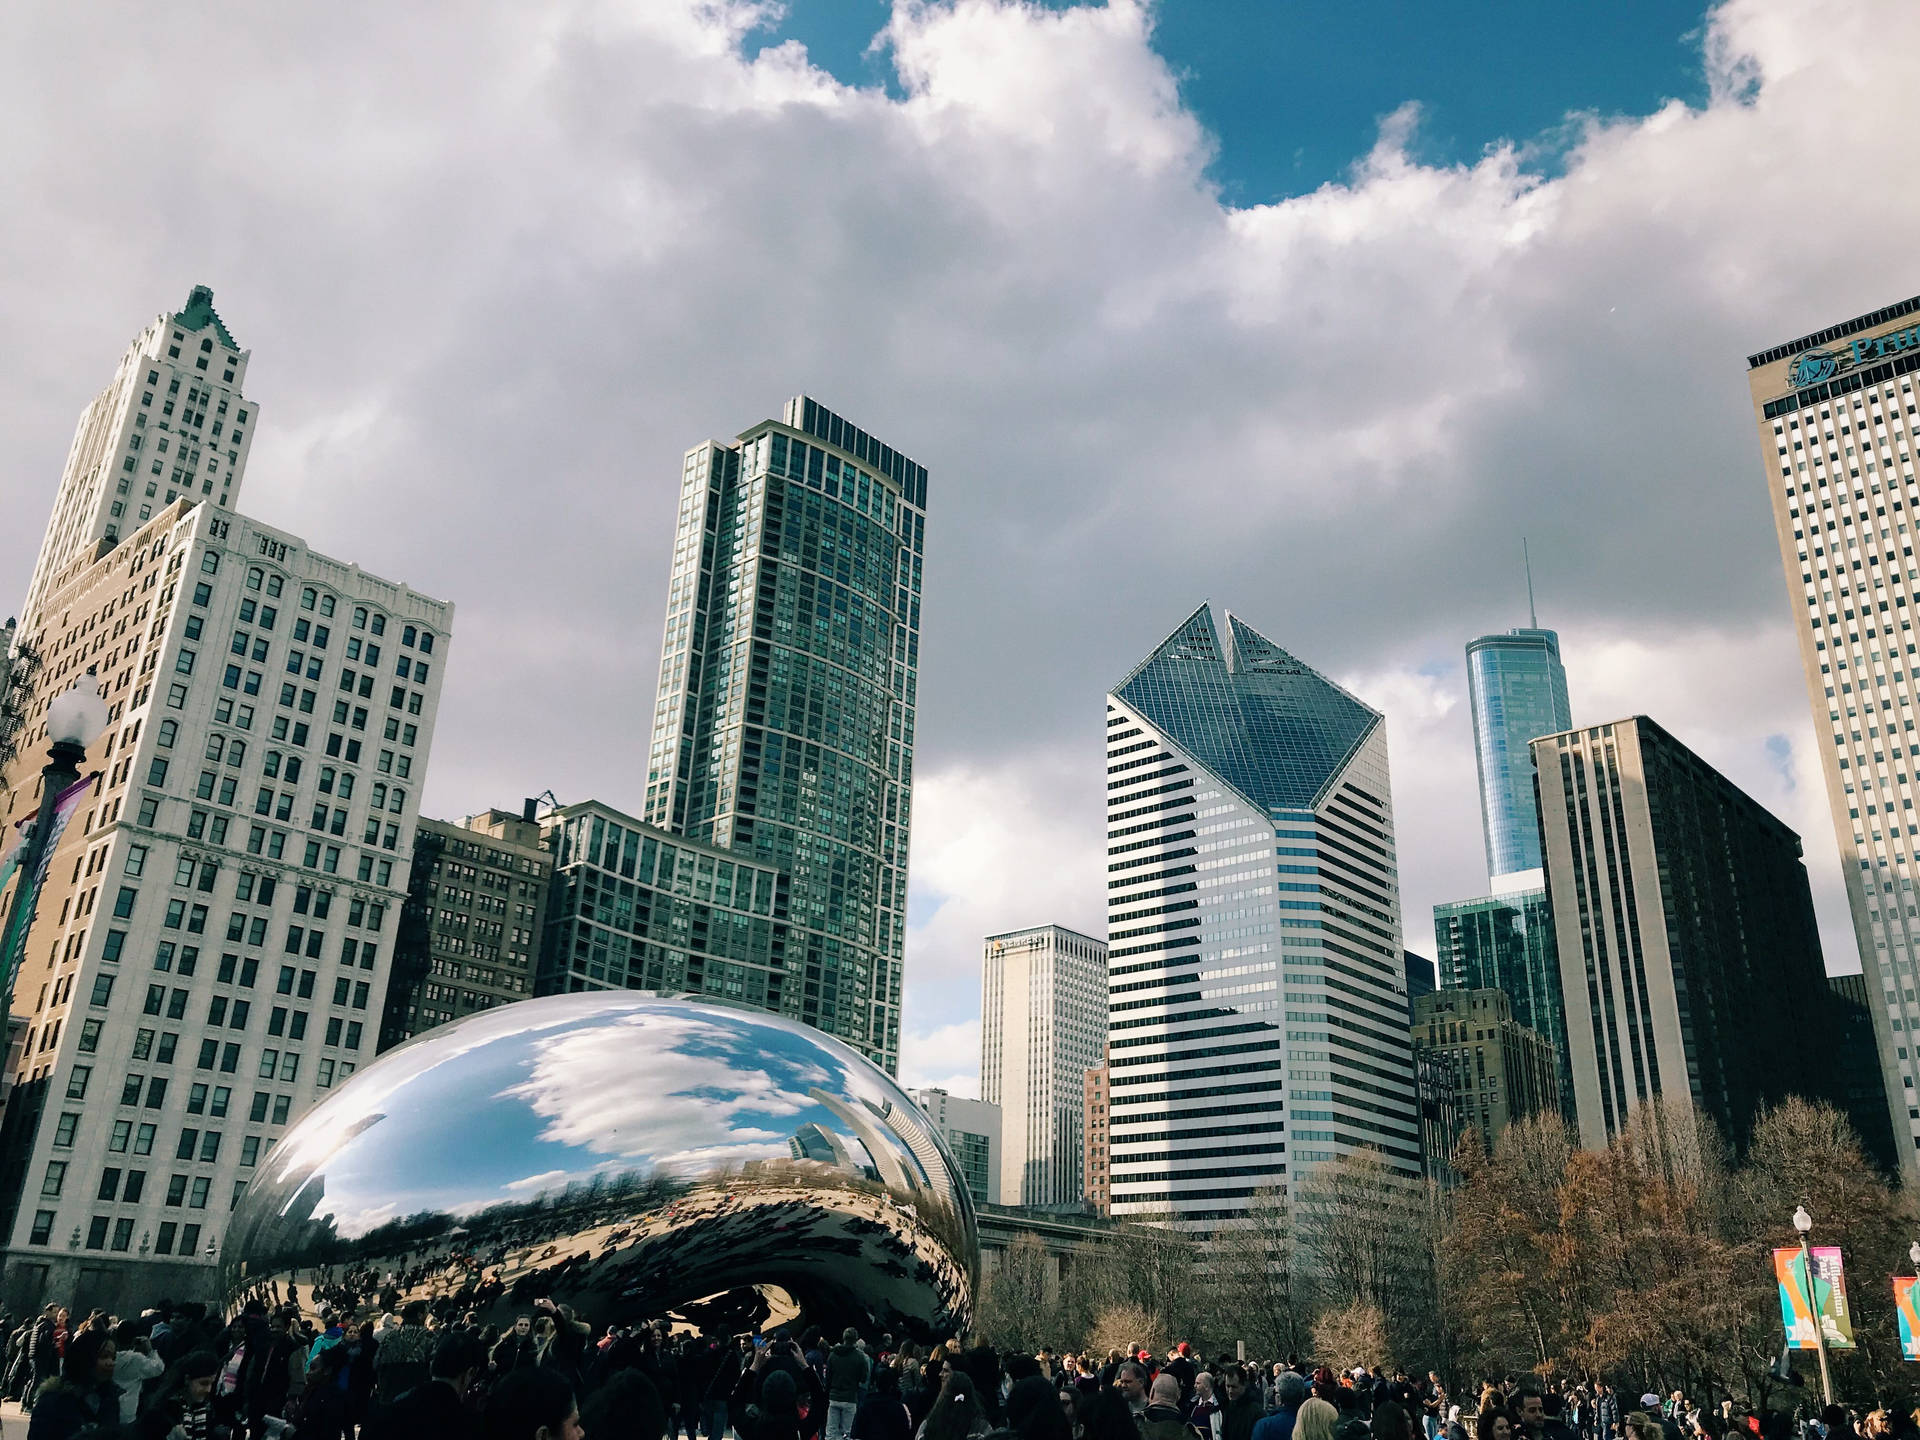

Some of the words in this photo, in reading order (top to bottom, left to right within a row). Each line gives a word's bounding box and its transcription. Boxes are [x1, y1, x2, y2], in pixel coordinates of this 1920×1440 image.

[1849, 325, 1920, 364] Pru
[1819, 1256, 1829, 1279] Park
[1829, 1256, 1844, 1316] Millennium
